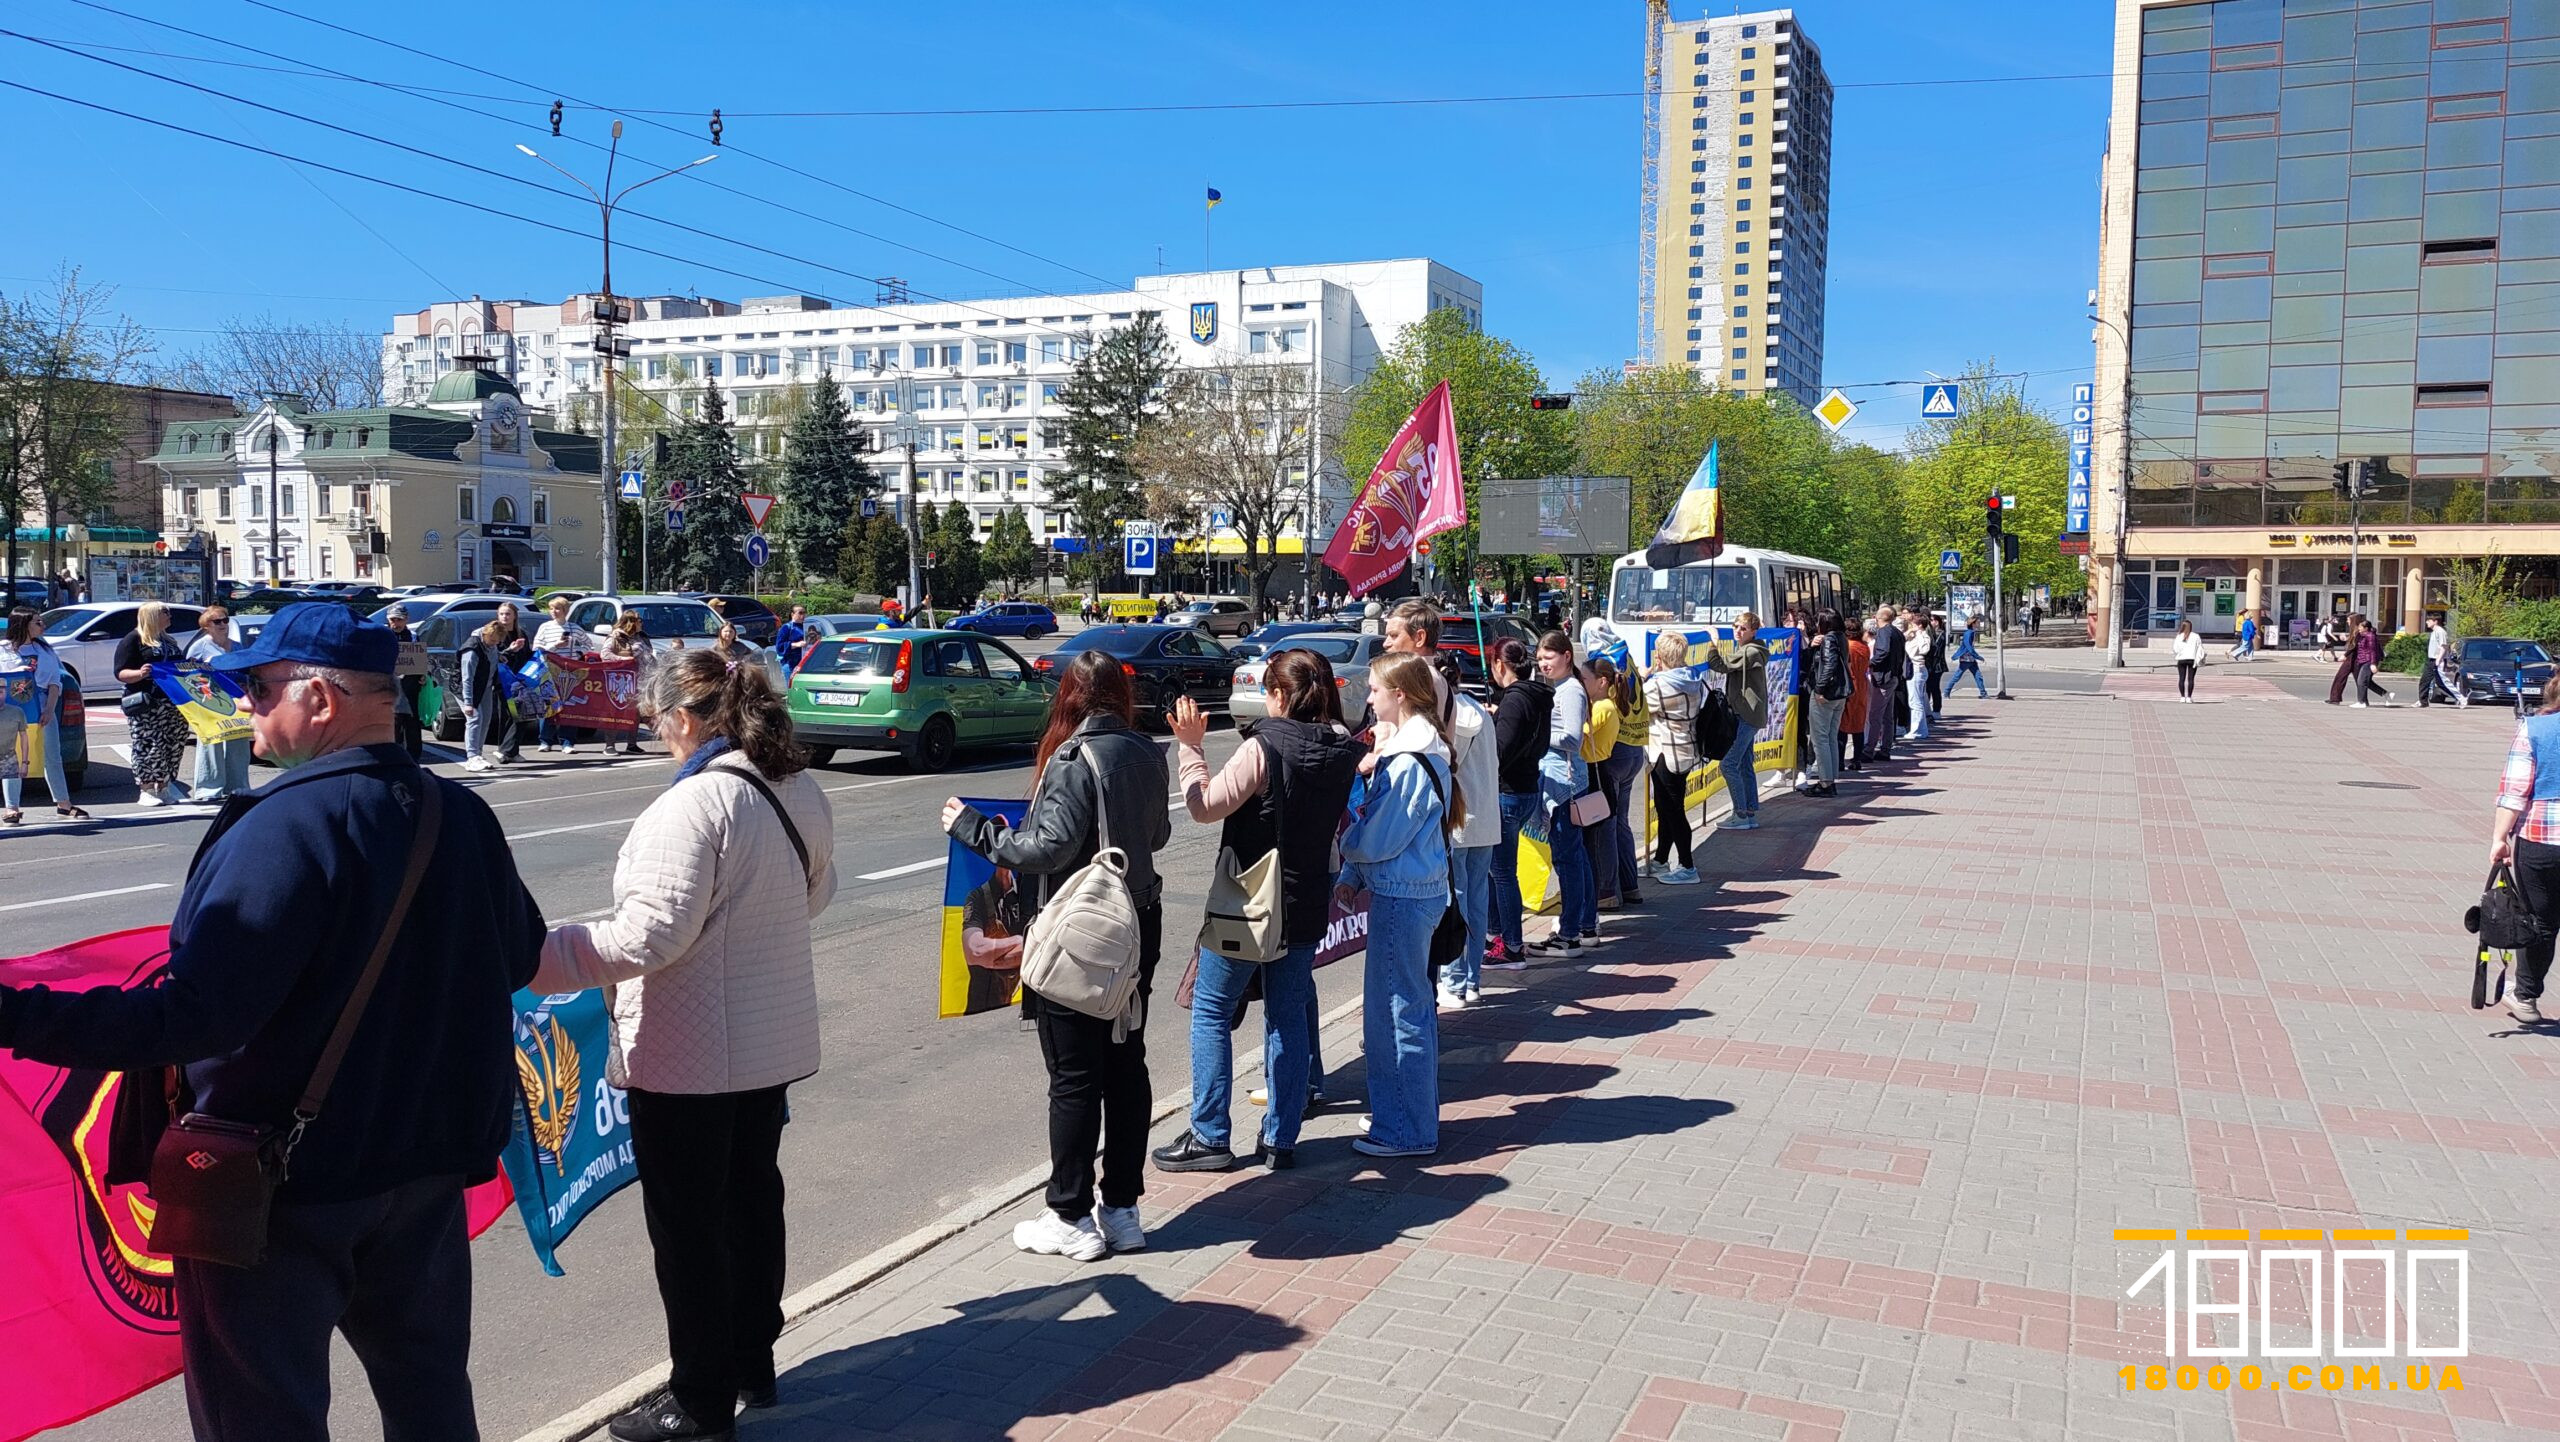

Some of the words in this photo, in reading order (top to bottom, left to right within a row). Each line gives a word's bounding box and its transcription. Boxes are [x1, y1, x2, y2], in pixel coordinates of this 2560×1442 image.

[2071, 385, 2091, 529] ПОШТАМТ
[1126, 524, 1155, 536] ЗОНА
[1131, 538, 1150, 566] P
[1111, 603, 1157, 613] ПОСИГНАЛЬ
[1715, 607, 1729, 622] 21
[583, 680, 603, 693] 82
